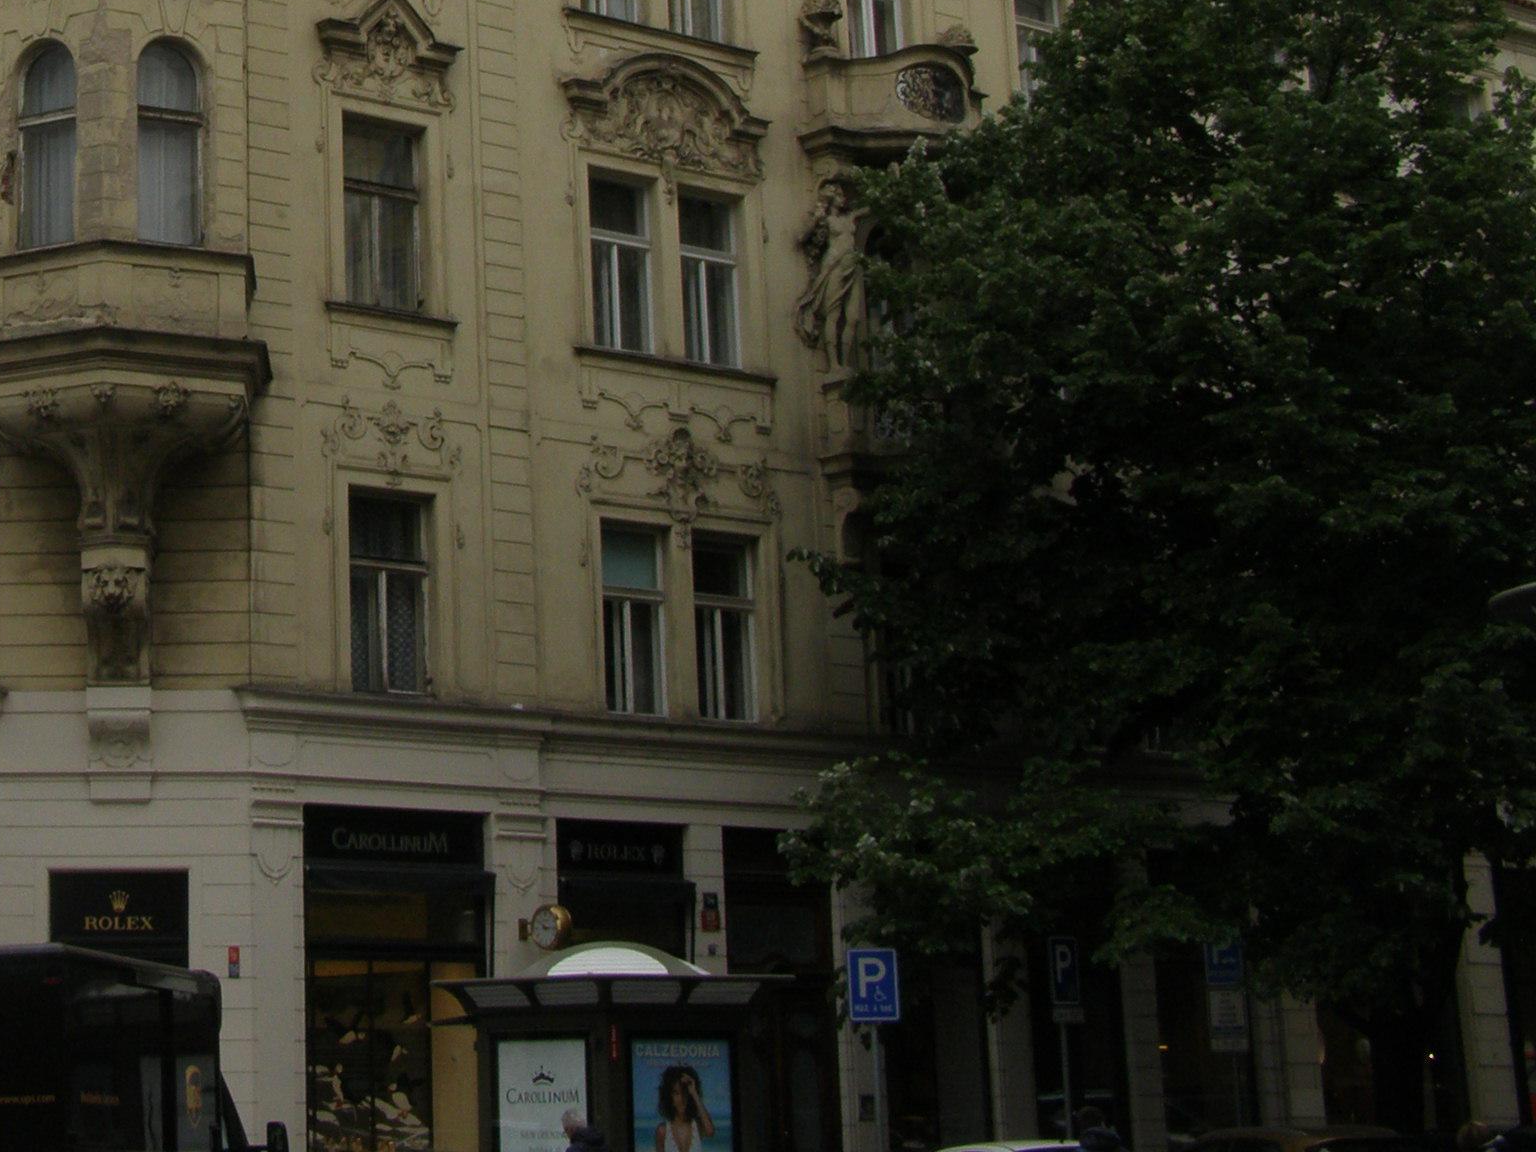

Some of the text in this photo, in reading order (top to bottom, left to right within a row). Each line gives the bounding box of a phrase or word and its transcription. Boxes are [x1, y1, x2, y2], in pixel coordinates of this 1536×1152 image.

[332, 827, 449, 853] CAROLLINUM
[586, 841, 647, 861] ROLEX
[83, 916, 155, 931] ROLEX
[1056, 944, 1072, 984] P
[858, 957, 886, 998] P
[635, 1043, 720, 1057] CALZEDONIA
[506, 1088, 581, 1105] CAROLLINUM
